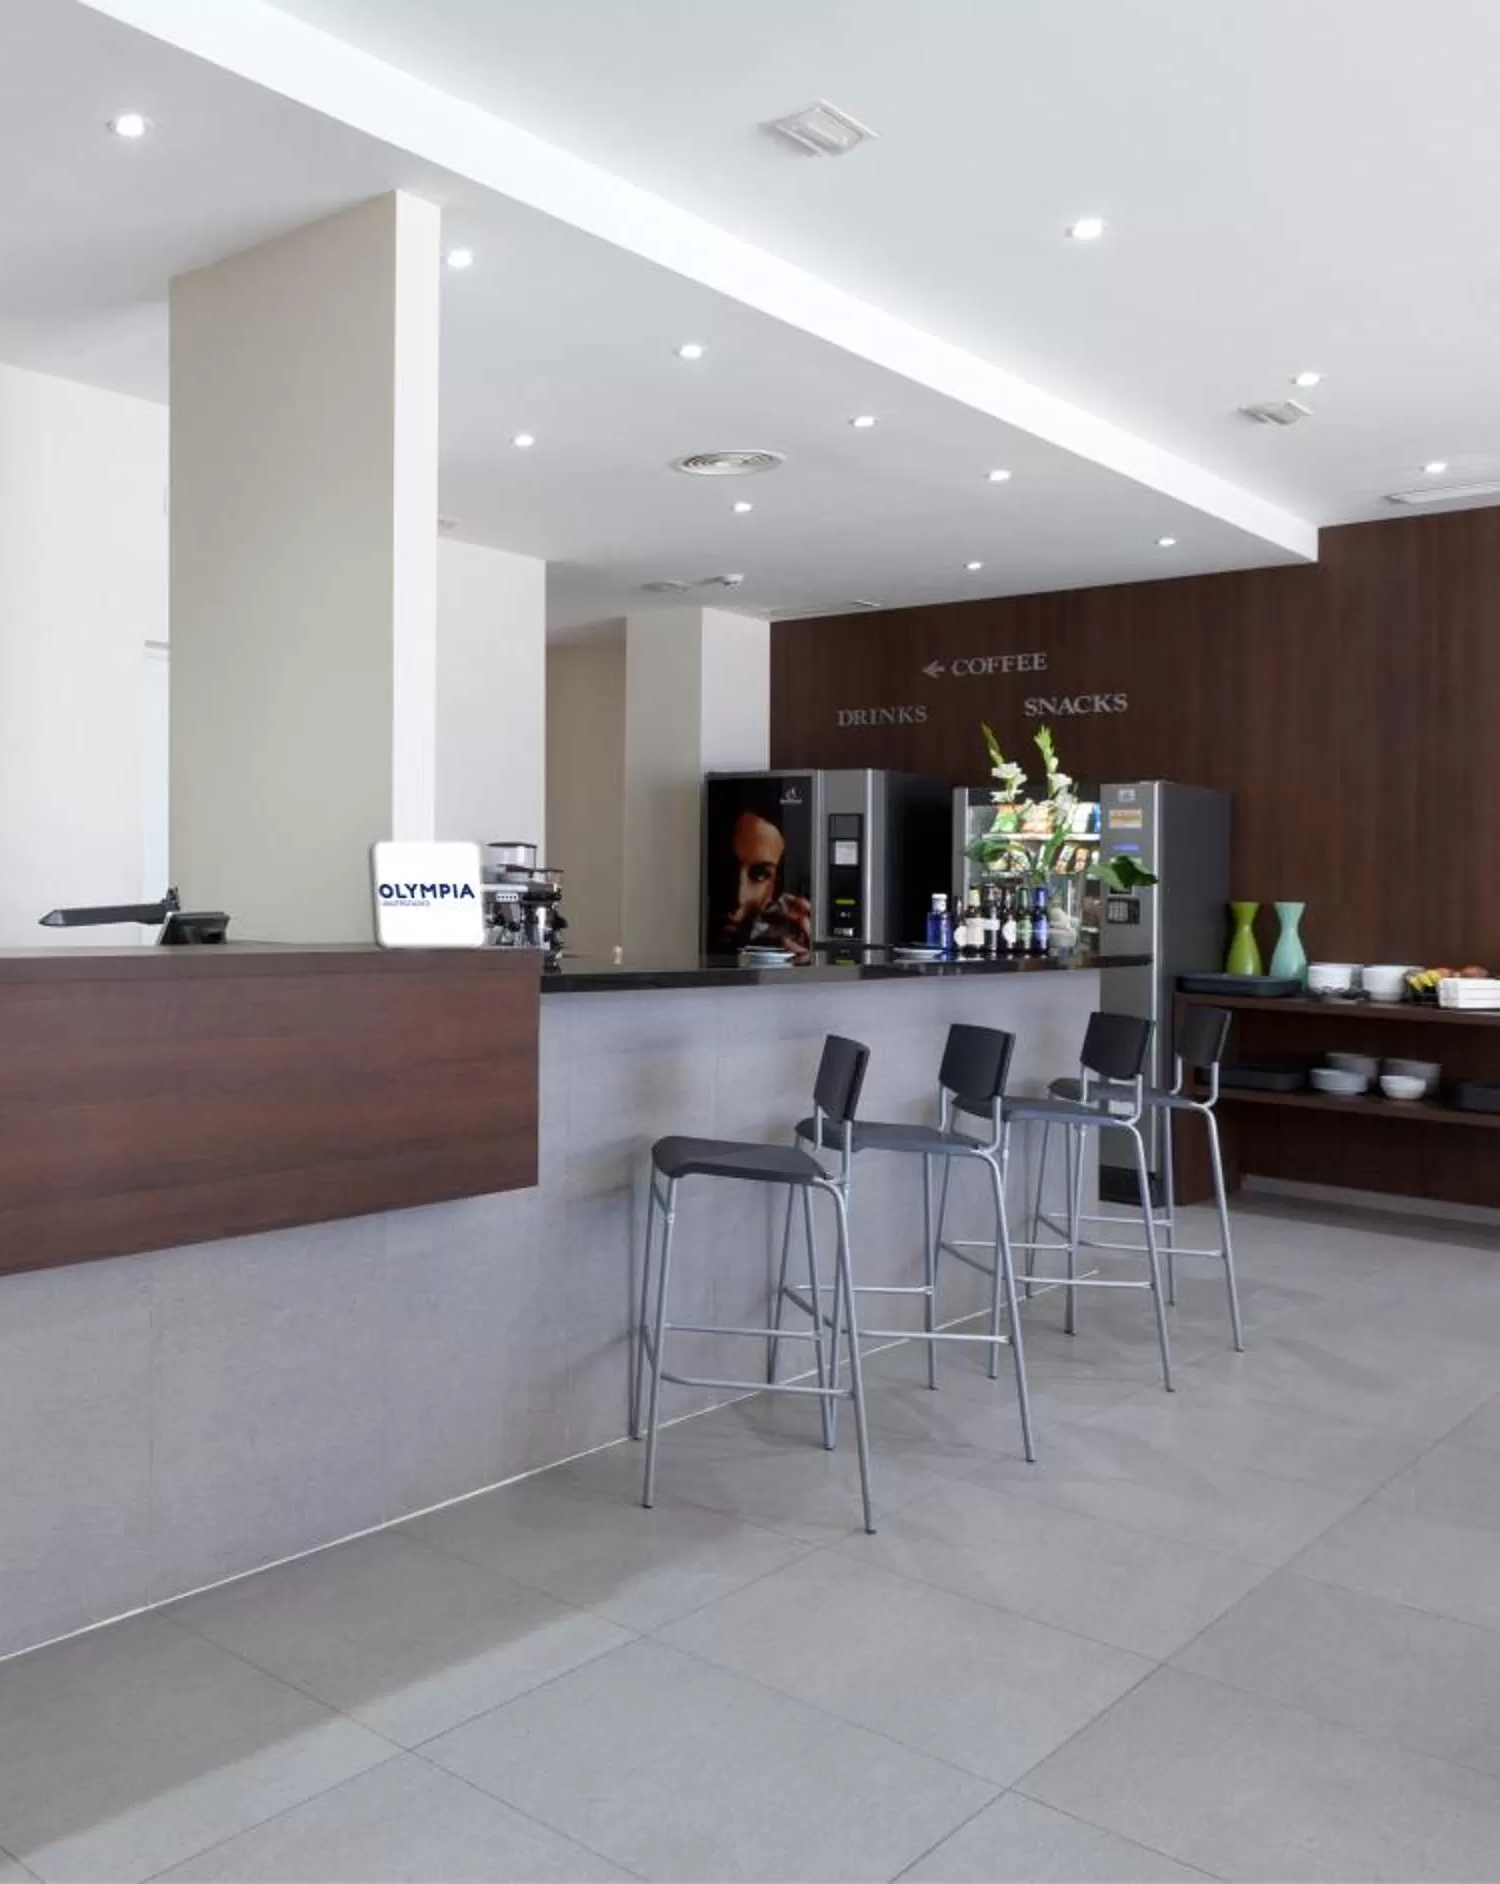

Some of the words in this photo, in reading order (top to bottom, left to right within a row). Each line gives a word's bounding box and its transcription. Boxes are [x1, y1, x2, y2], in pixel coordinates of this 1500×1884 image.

[951, 652, 1048, 676] COFFEE
[836, 705, 928, 727] DRINKS
[1024, 693, 1128, 717] SNACKS
[379, 883, 476, 899] OLYMPIA
